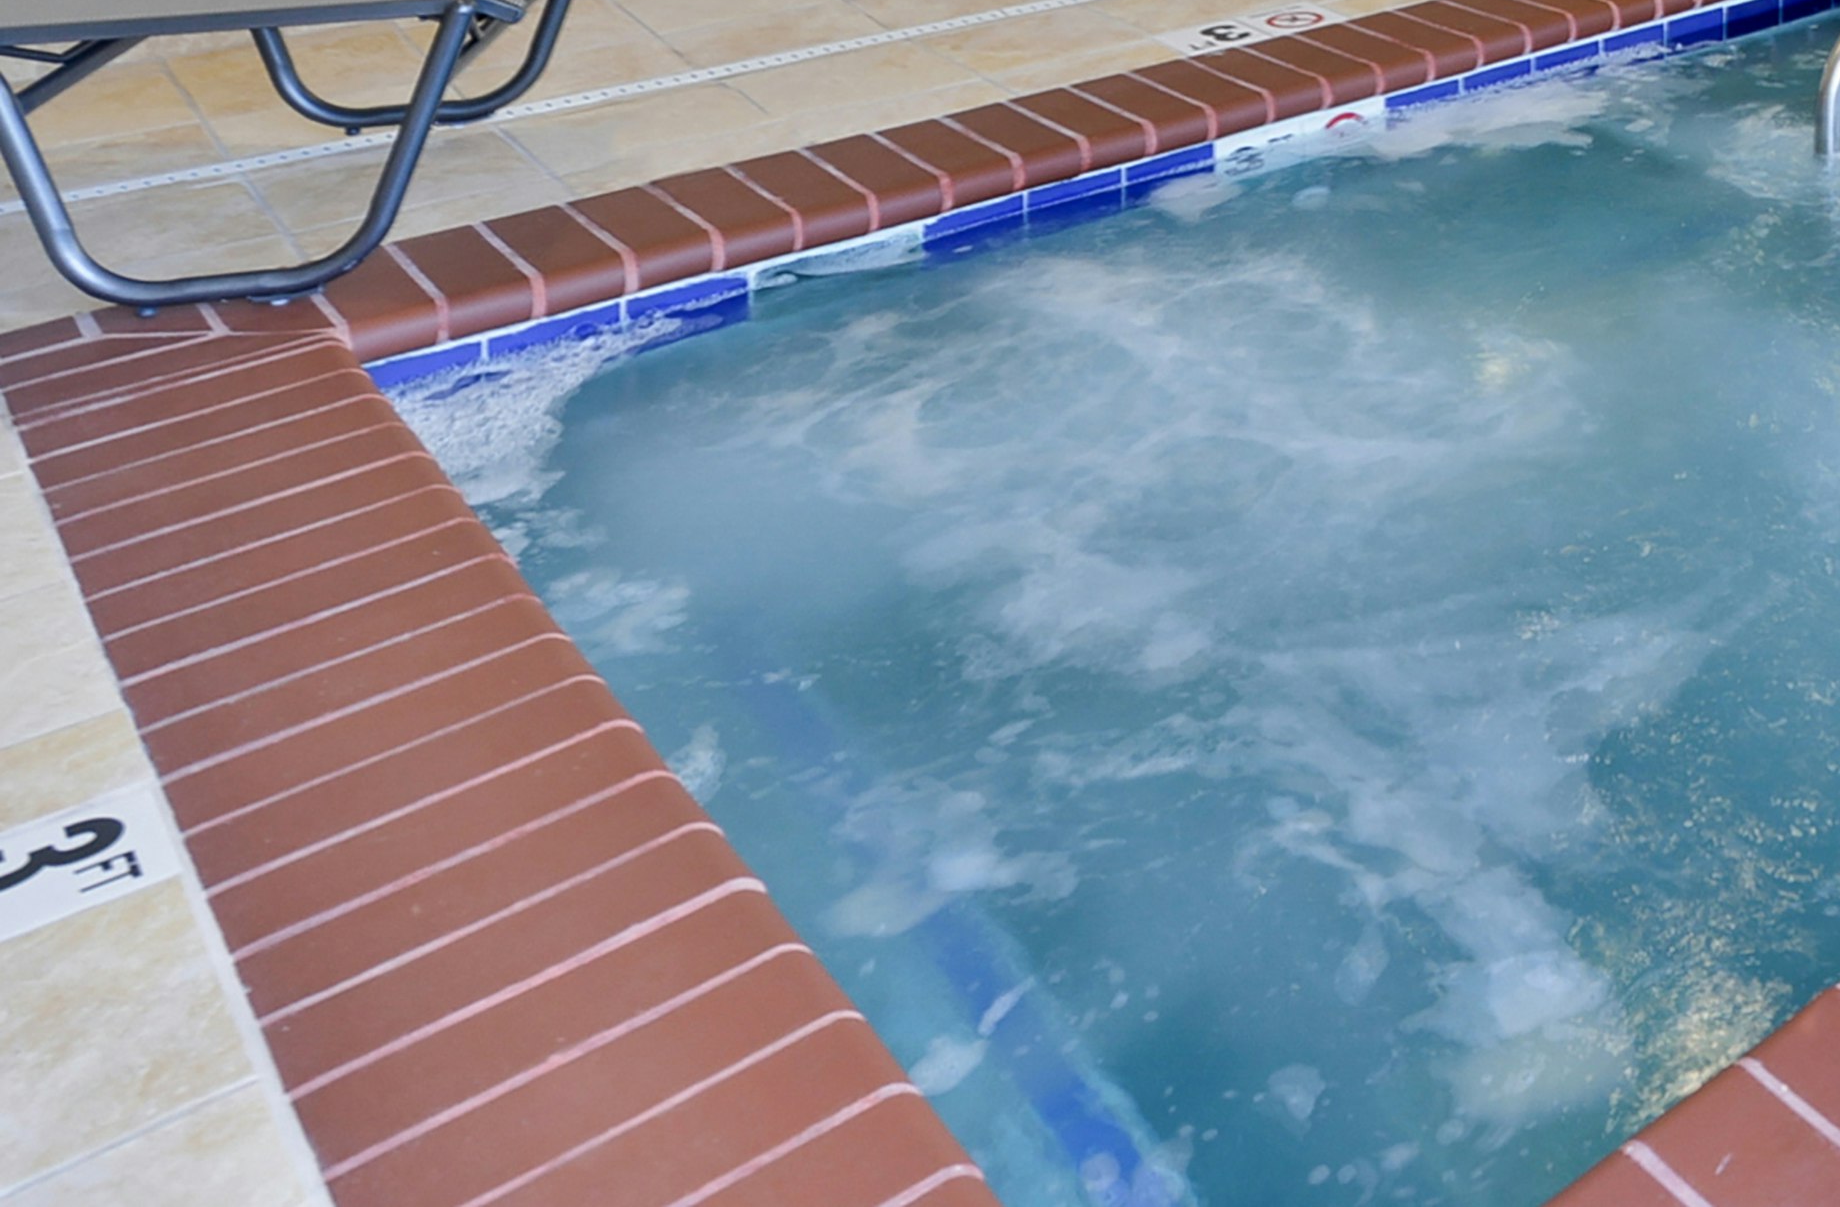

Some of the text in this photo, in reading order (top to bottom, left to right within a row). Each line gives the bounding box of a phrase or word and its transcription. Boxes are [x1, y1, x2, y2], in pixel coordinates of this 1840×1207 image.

[1200, 25, 1251, 42] 3
[0, 817, 144, 894] 3 FT
